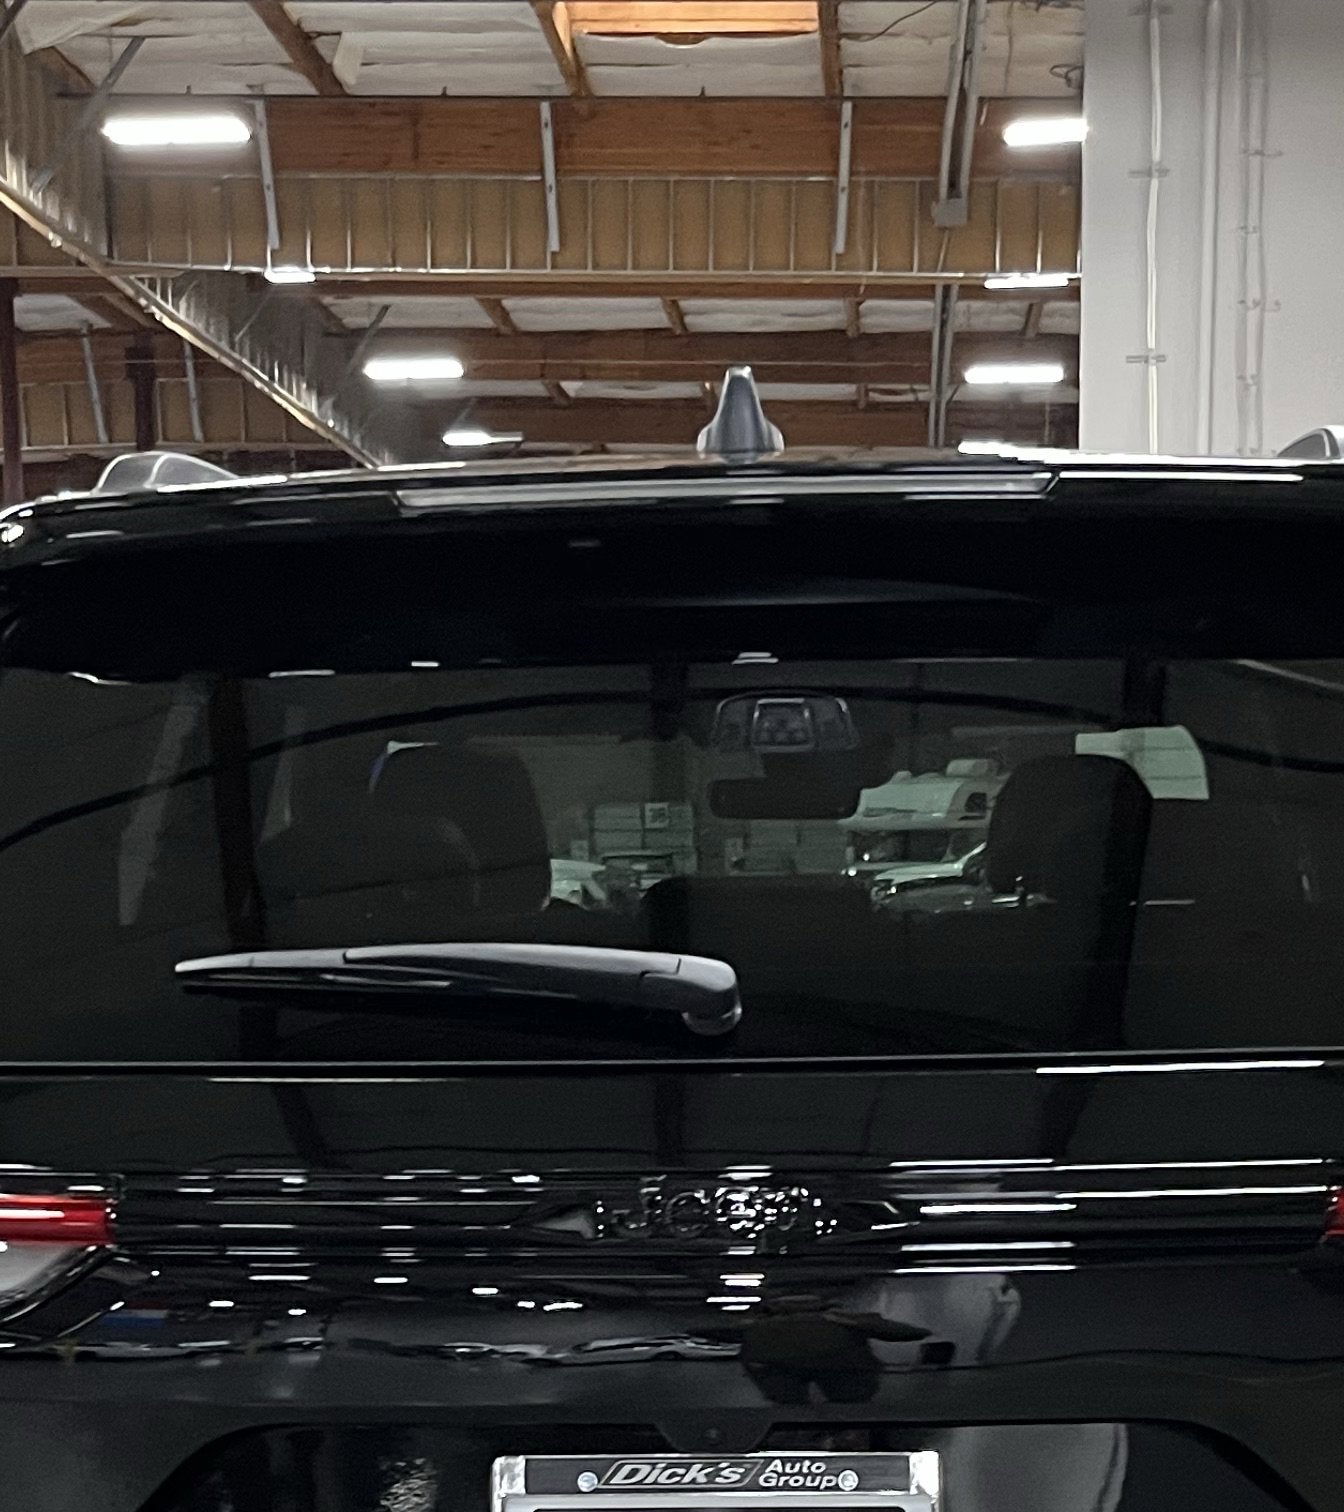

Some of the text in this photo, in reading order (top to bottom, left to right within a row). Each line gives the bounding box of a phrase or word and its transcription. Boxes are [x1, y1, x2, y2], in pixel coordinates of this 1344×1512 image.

[607, 1461, 747, 1485] Dick's
[766, 1458, 827, 1475] Auto
[758, 1472, 839, 1491] Group
